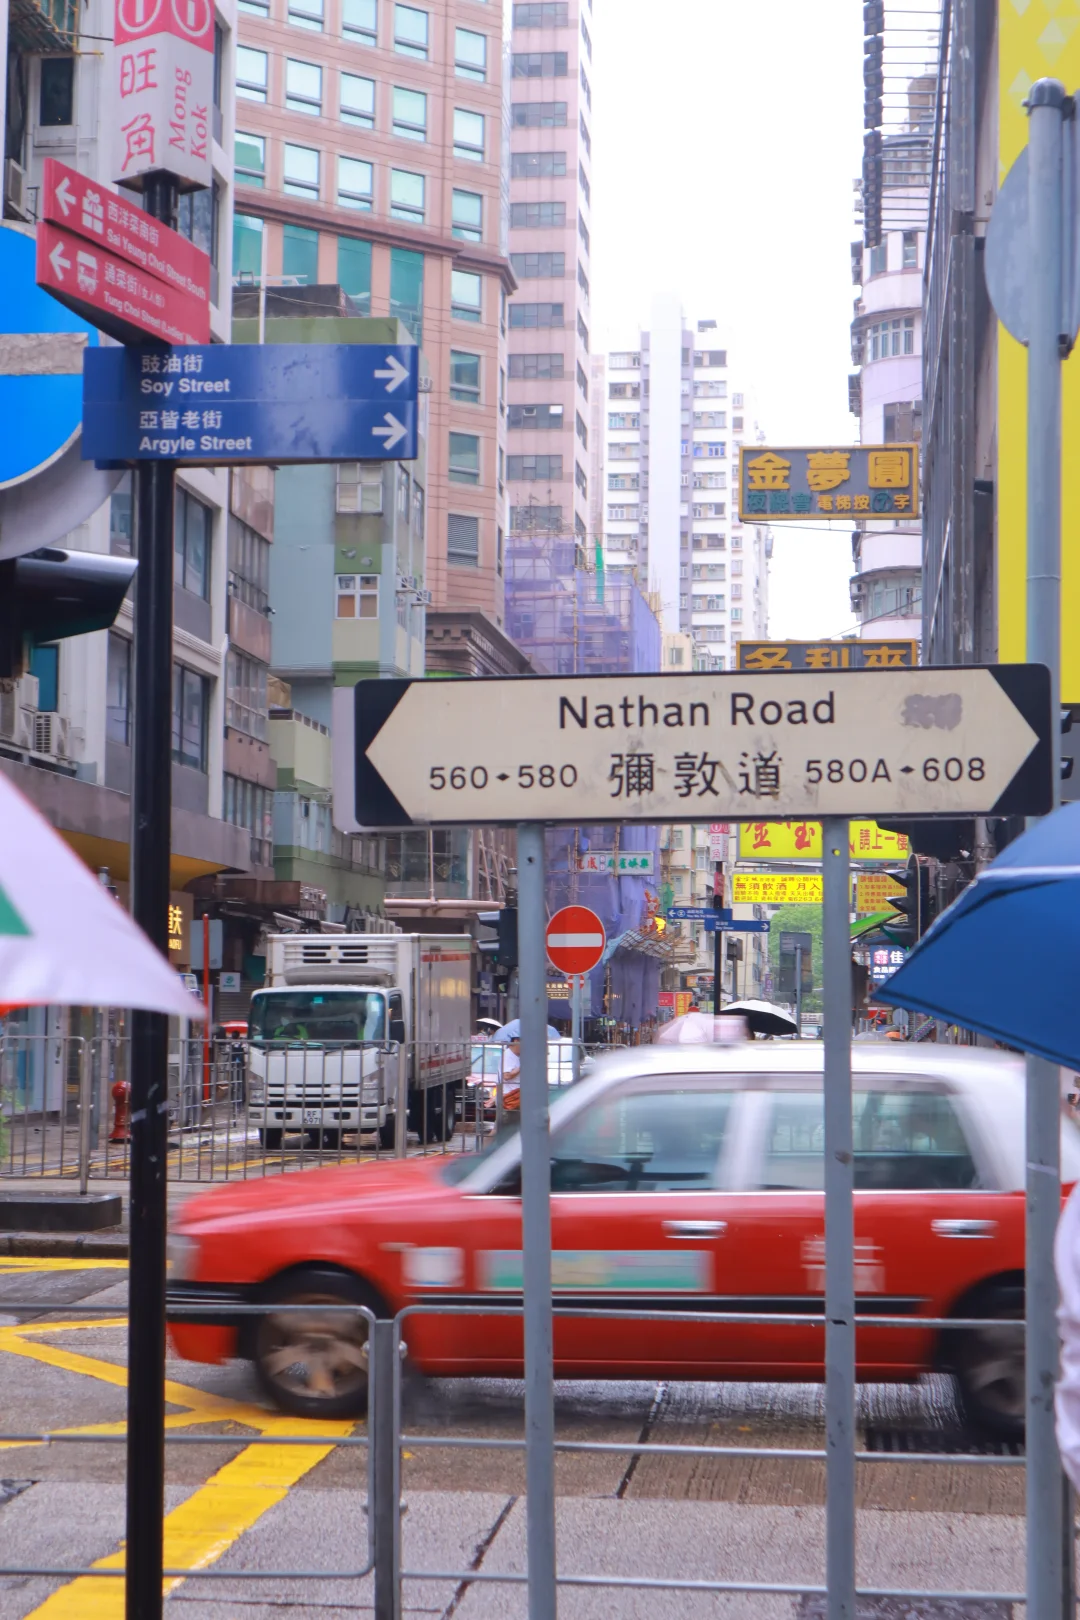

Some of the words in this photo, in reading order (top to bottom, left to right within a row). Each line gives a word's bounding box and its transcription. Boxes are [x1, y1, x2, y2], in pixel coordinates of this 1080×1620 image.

[120, 48, 158, 172] 旺角
[168, 65, 192, 152] Mong
[190, 102, 208, 162] Kok
[107, 228, 120, 247] Sai
[122, 236, 147, 265] Yeung
[148, 253, 166, 273] Choi
[167, 264, 186, 287] Street
[187, 277, 206, 300] South
[104, 291, 123, 312] Tung
[124, 301, 140, 318] Choi
[141, 310, 160, 329] Street
[141, 354, 203, 373] 豉油街
[141, 379, 174, 397] Soy
[178, 378, 231, 393] Street
[139, 410, 222, 430] 亞皆老街
[139, 436, 195, 454] Argyle
[200, 435, 252, 450] Street
[559, 695, 710, 729] Nathan
[730, 690, 836, 726] Road
[429, 766, 489, 790] 560
[517, 764, 578, 789] 580
[609, 751, 782, 797] 彌敦道
[805, 758, 892, 784] 580A
[922, 757, 986, 782] 608
